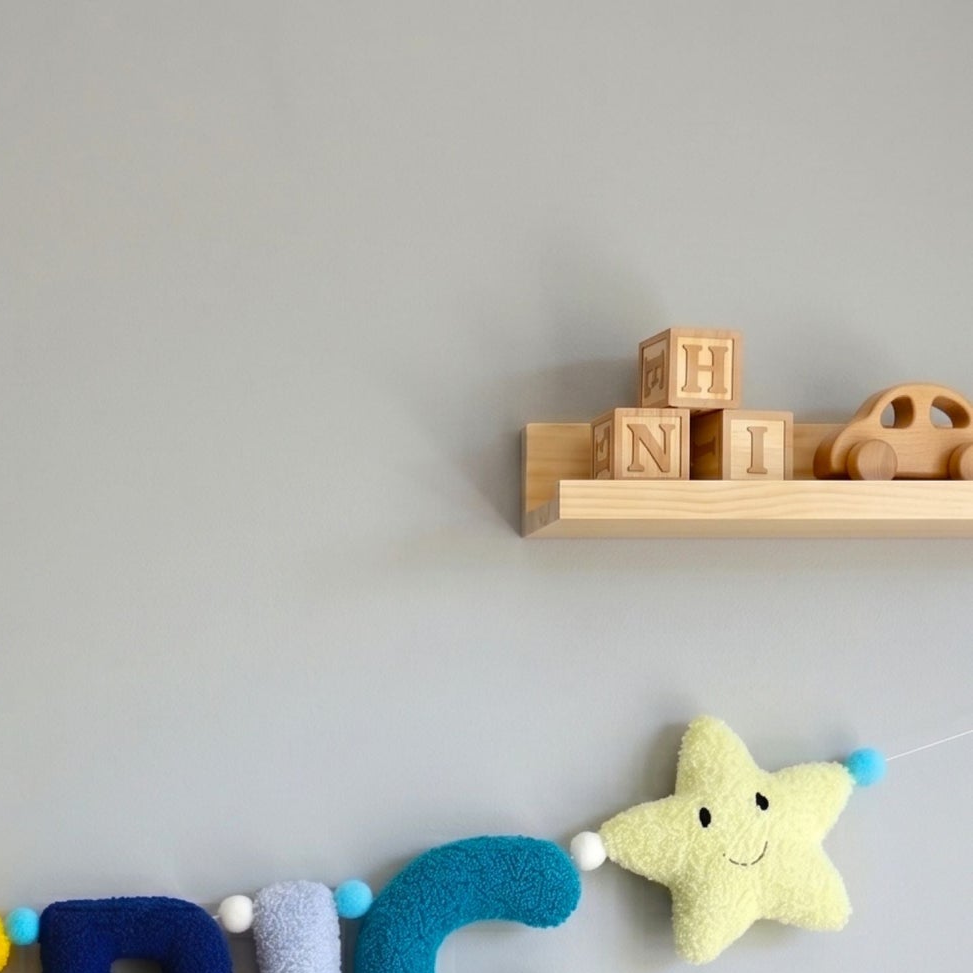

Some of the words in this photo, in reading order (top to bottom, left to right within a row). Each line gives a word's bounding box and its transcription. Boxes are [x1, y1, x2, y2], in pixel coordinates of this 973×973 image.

[681, 344, 729, 393] H
[627, 423, 676, 472] N
[746, 426, 768, 474] I
